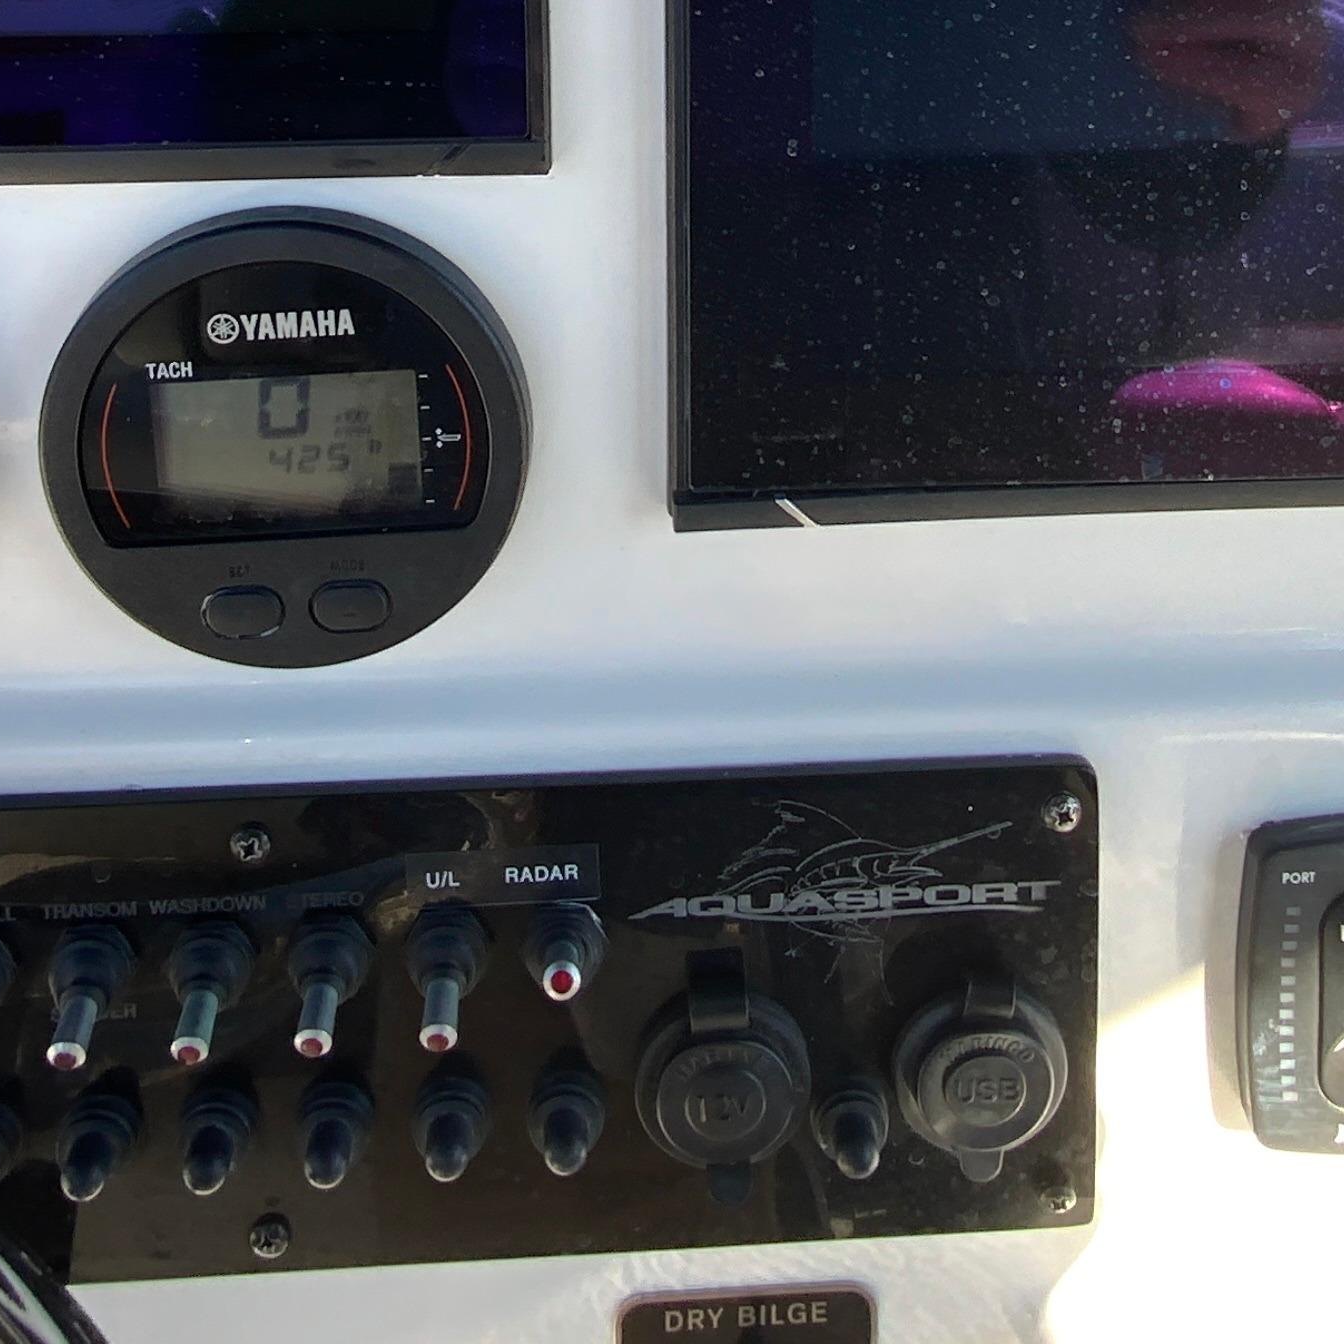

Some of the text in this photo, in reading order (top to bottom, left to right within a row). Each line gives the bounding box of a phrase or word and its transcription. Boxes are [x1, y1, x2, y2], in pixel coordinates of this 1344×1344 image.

[239, 308, 355, 341] YAMAHA
[146, 362, 193, 379] TACH
[425, 862, 580, 889] U/L RADAR
[1282, 872, 1316, 885] PORT
[42, 900, 138, 921] TRANSOM
[149, 893, 267, 916] WASHDOWN
[627, 880, 1061, 919] AQUASPORT
[957, 1075, 1021, 1105] USB
[664, 1302, 828, 1333] DRY BILGE
